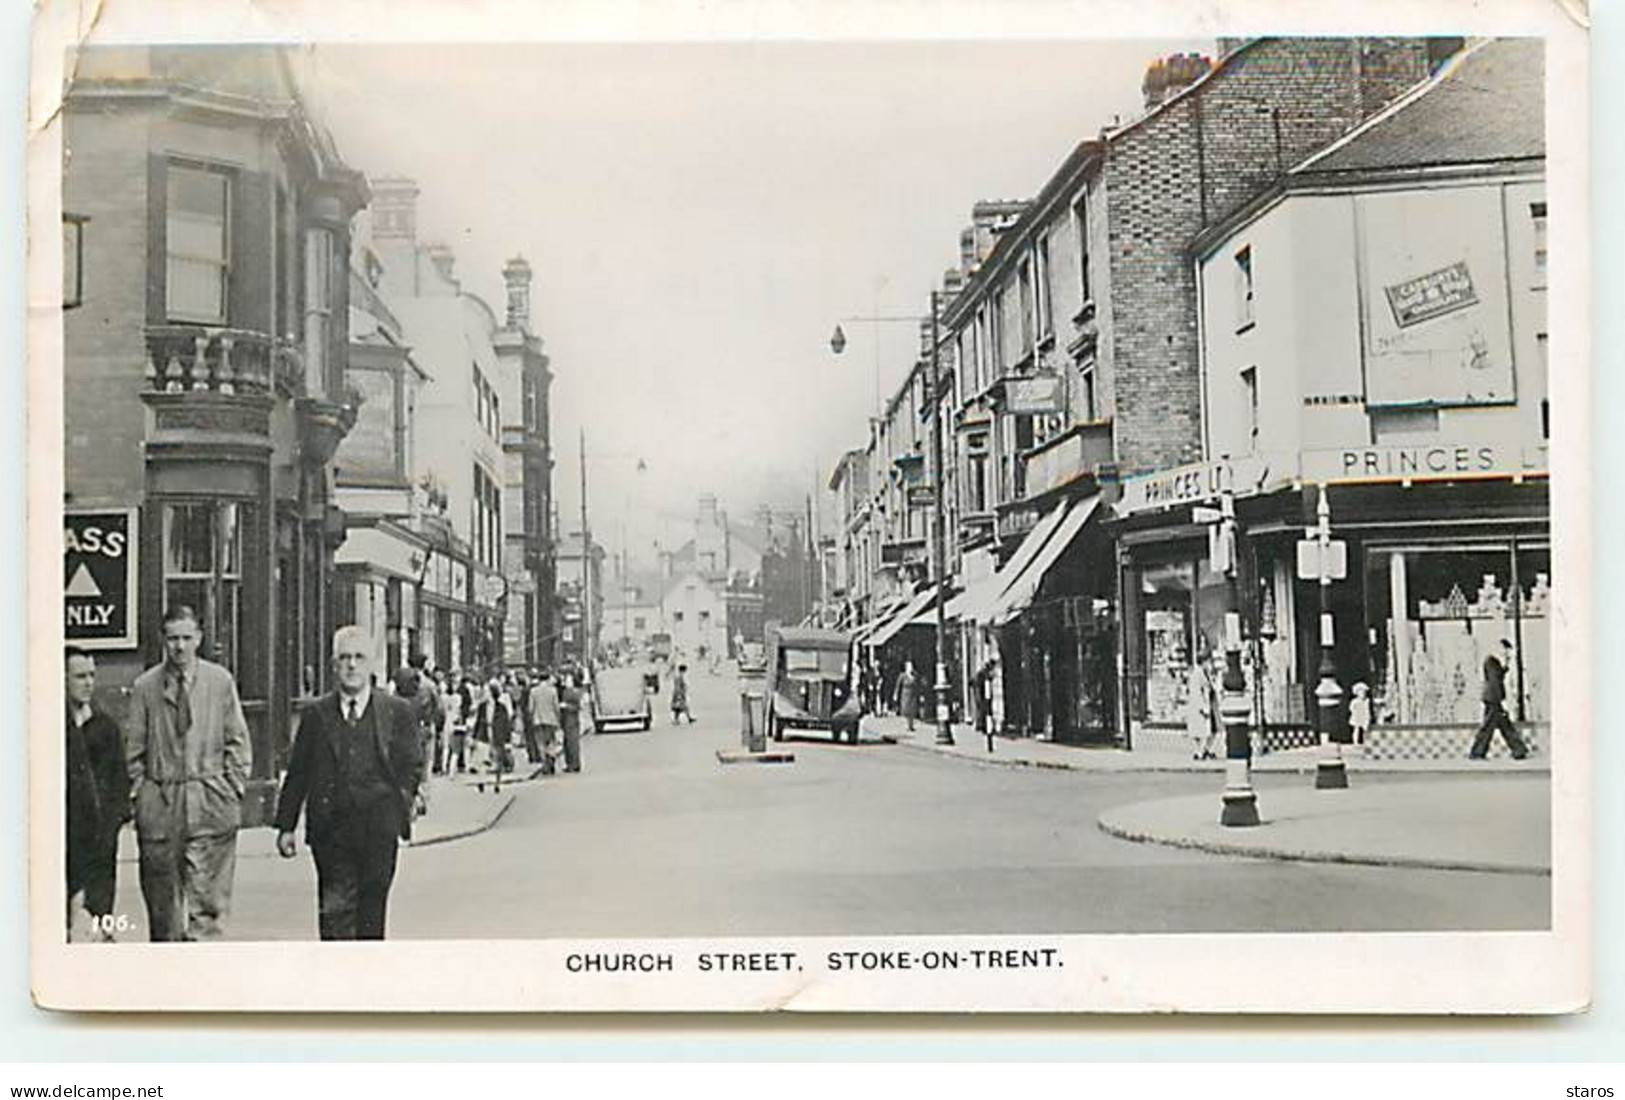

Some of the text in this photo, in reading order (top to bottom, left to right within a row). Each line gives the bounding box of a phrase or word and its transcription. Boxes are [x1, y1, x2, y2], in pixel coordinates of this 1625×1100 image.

[1343, 448, 1494, 474] PRINCES
[1145, 471, 1201, 502] PRINCES
[67, 604, 116, 626] NLY
